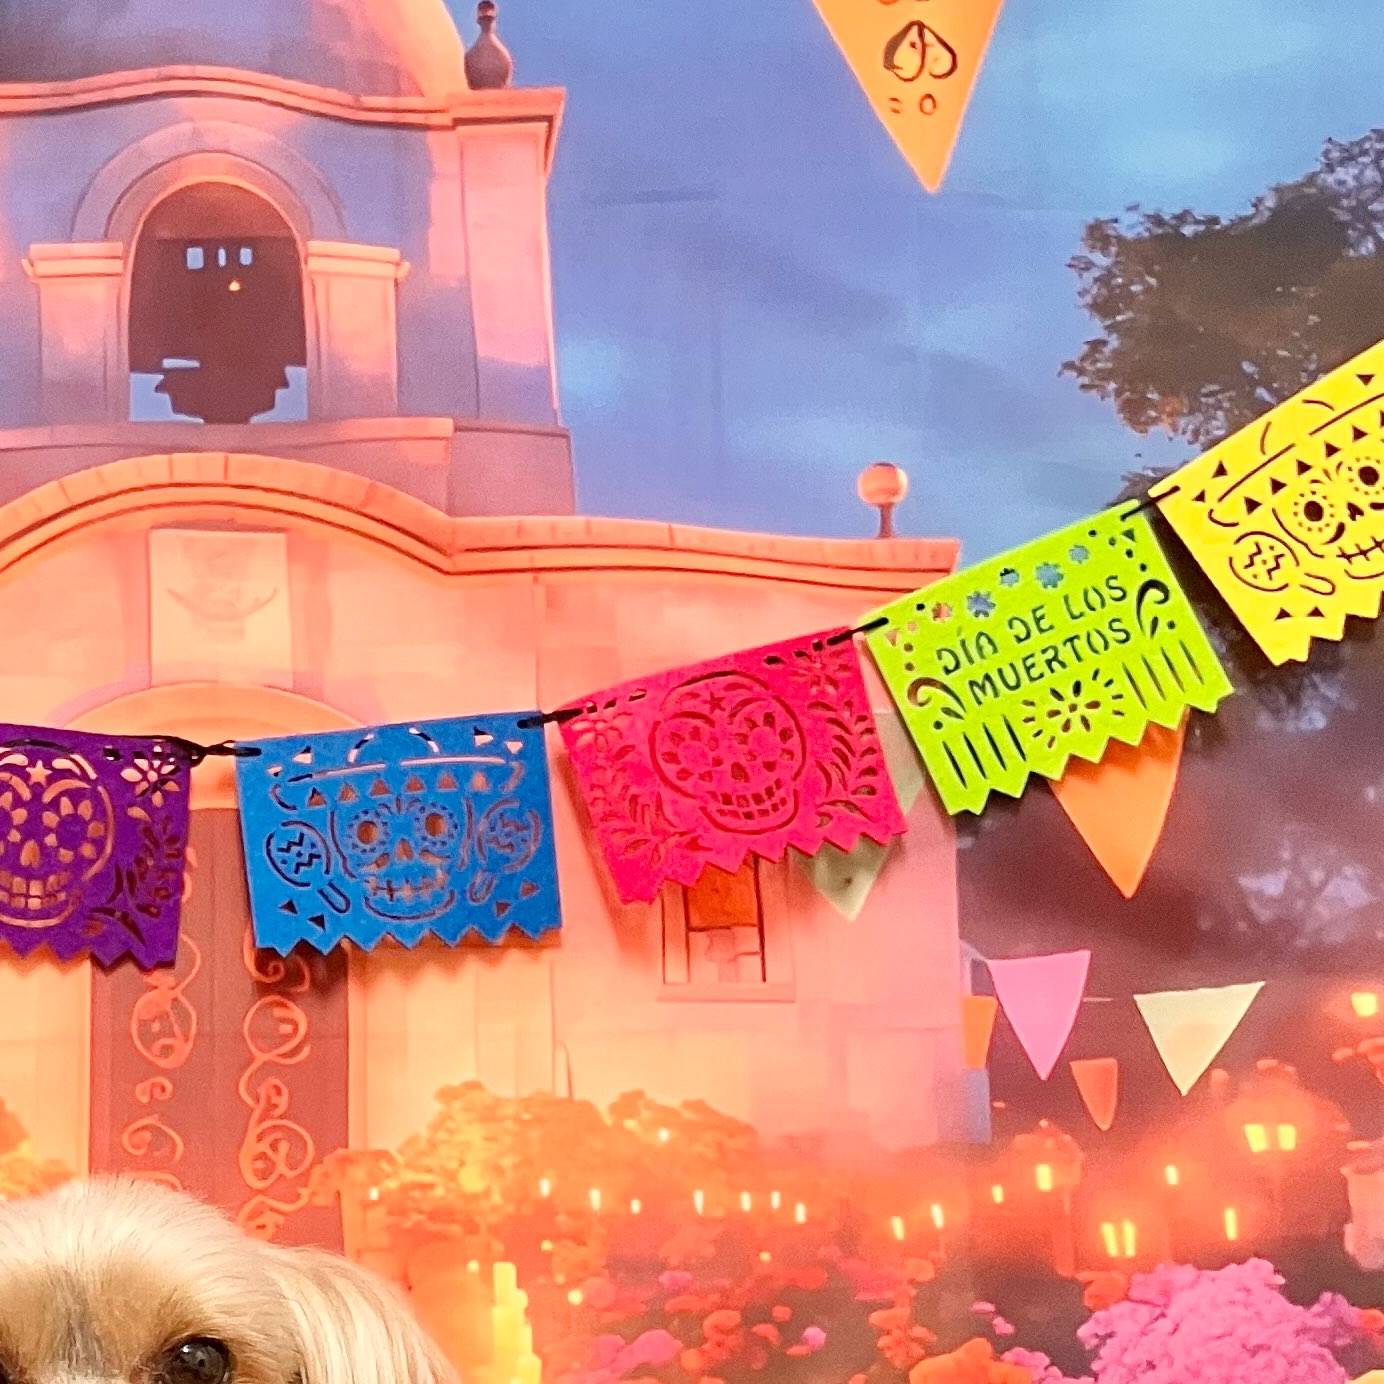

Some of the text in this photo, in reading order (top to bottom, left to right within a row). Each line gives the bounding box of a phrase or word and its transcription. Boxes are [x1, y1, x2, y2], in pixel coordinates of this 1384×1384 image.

[1008, 605, 1055, 644] DE
[1064, 575, 1127, 620] LOS
[968, 617, 1132, 706] MUERTOS
